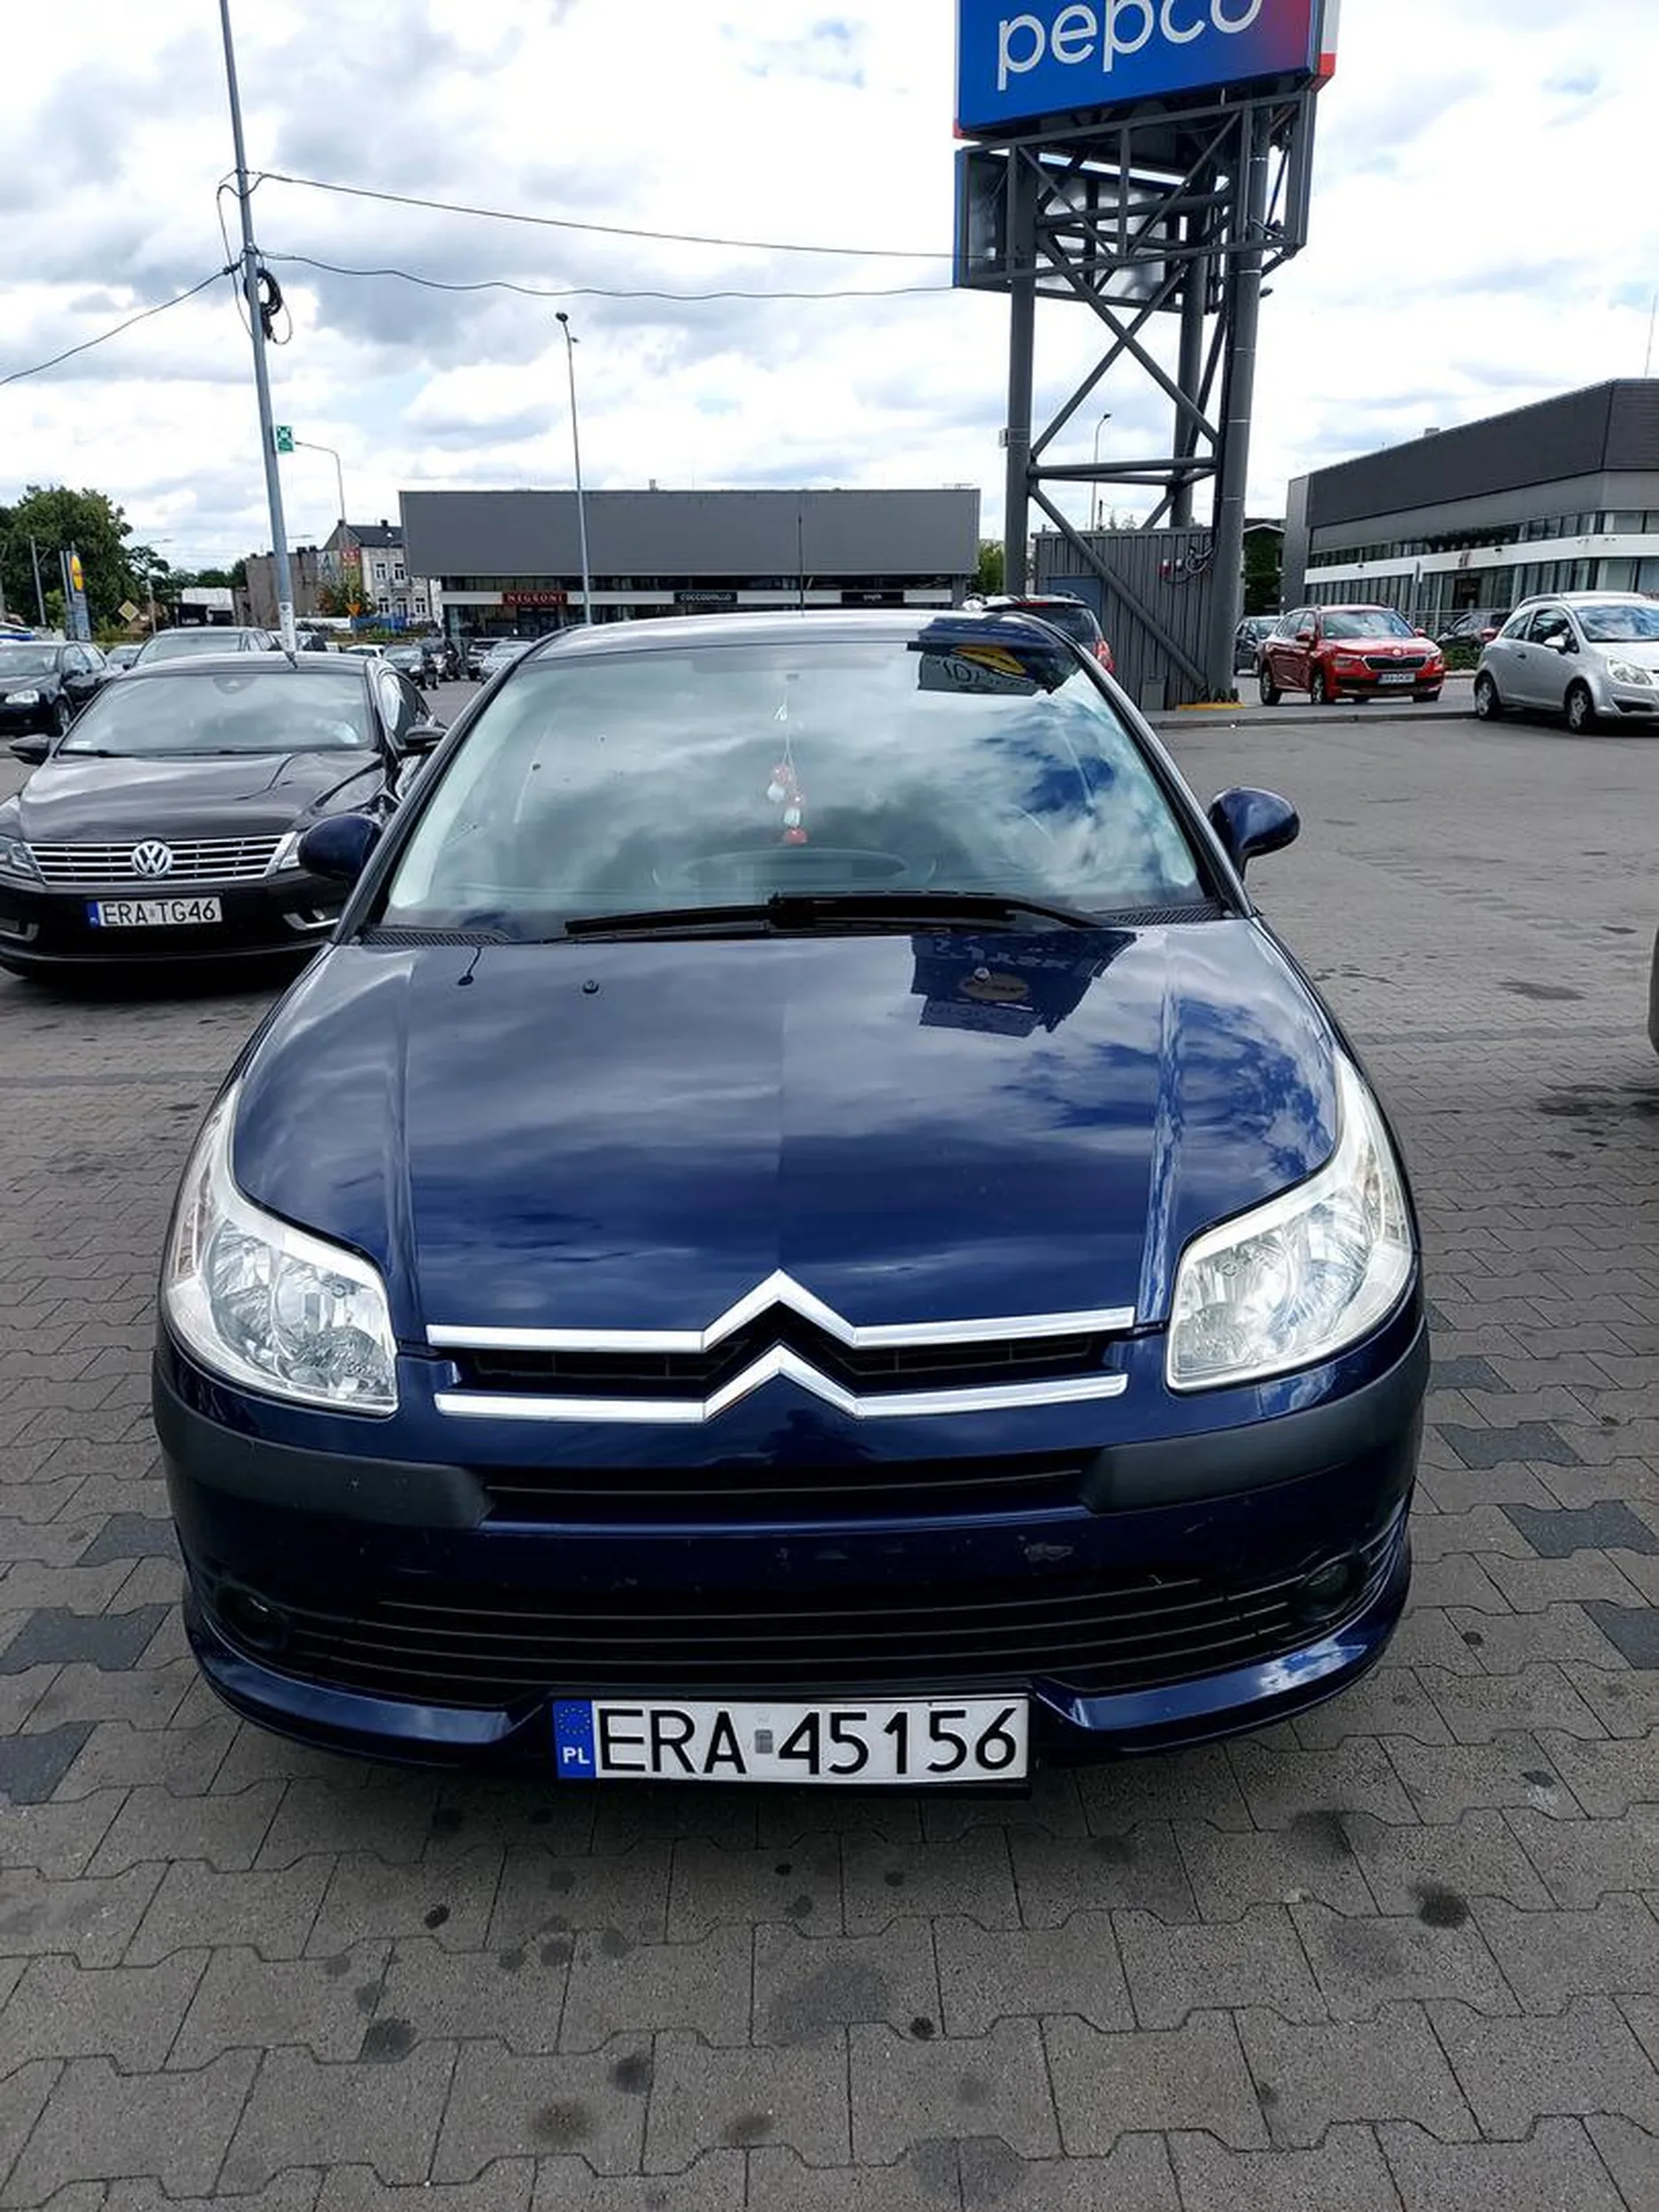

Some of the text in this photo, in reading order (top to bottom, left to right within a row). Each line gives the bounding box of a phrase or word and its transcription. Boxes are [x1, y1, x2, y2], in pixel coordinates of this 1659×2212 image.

[997, 0, 1263, 91] pepco
[102, 902, 149, 925] ERA
[155, 900, 216, 922] TG46
[563, 1746, 591, 1765] PL
[598, 1708, 1018, 1776] ERA 45156
